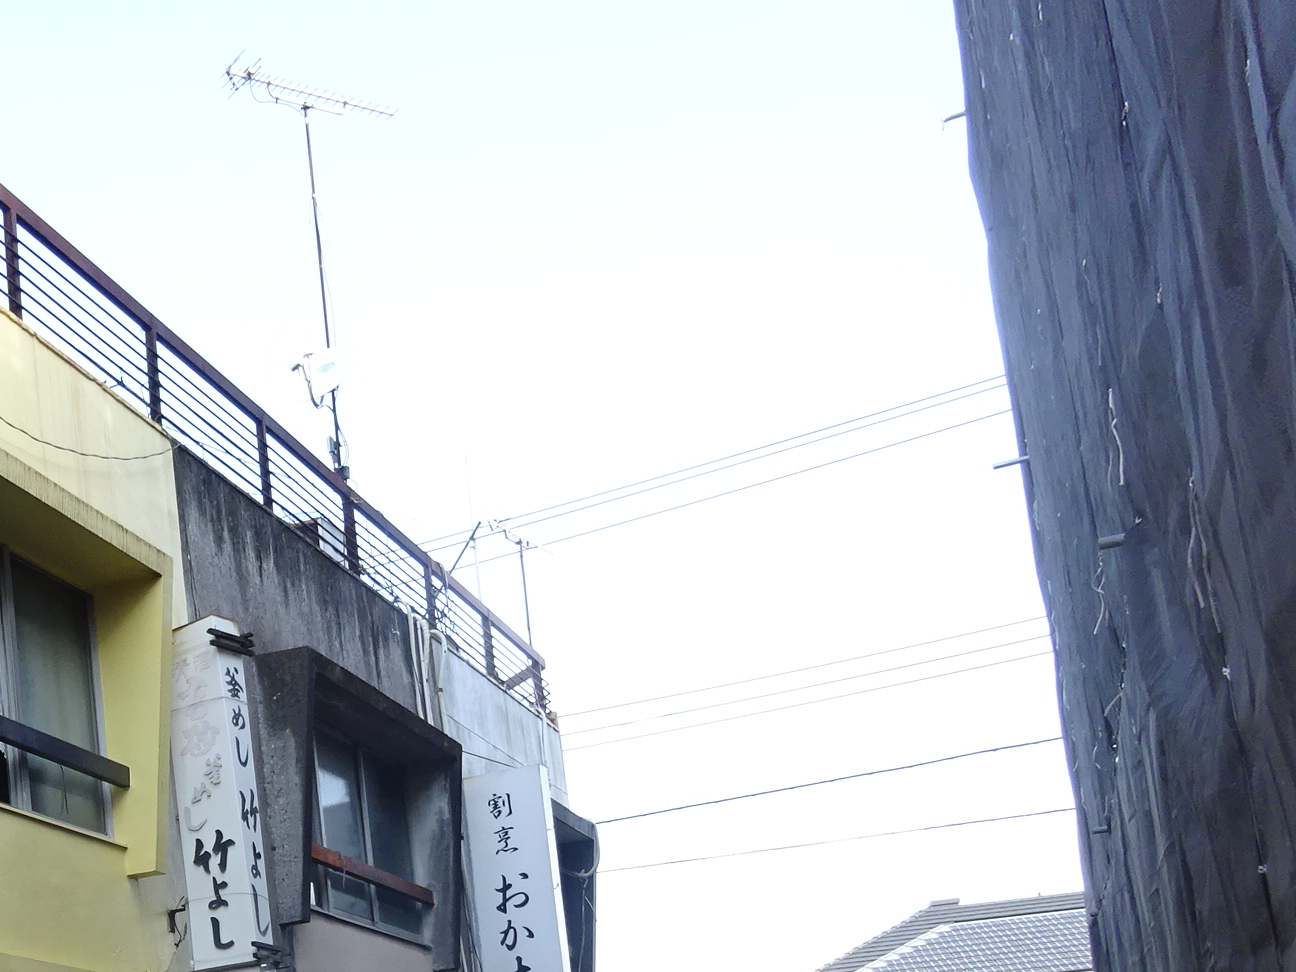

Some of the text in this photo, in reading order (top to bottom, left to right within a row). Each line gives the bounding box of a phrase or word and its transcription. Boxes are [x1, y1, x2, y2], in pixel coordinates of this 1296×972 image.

[224, 666, 270, 938] 釜めし 竹よし
[487, 792, 519, 856] 割烹
[193, 828, 236, 951] 竹よし
